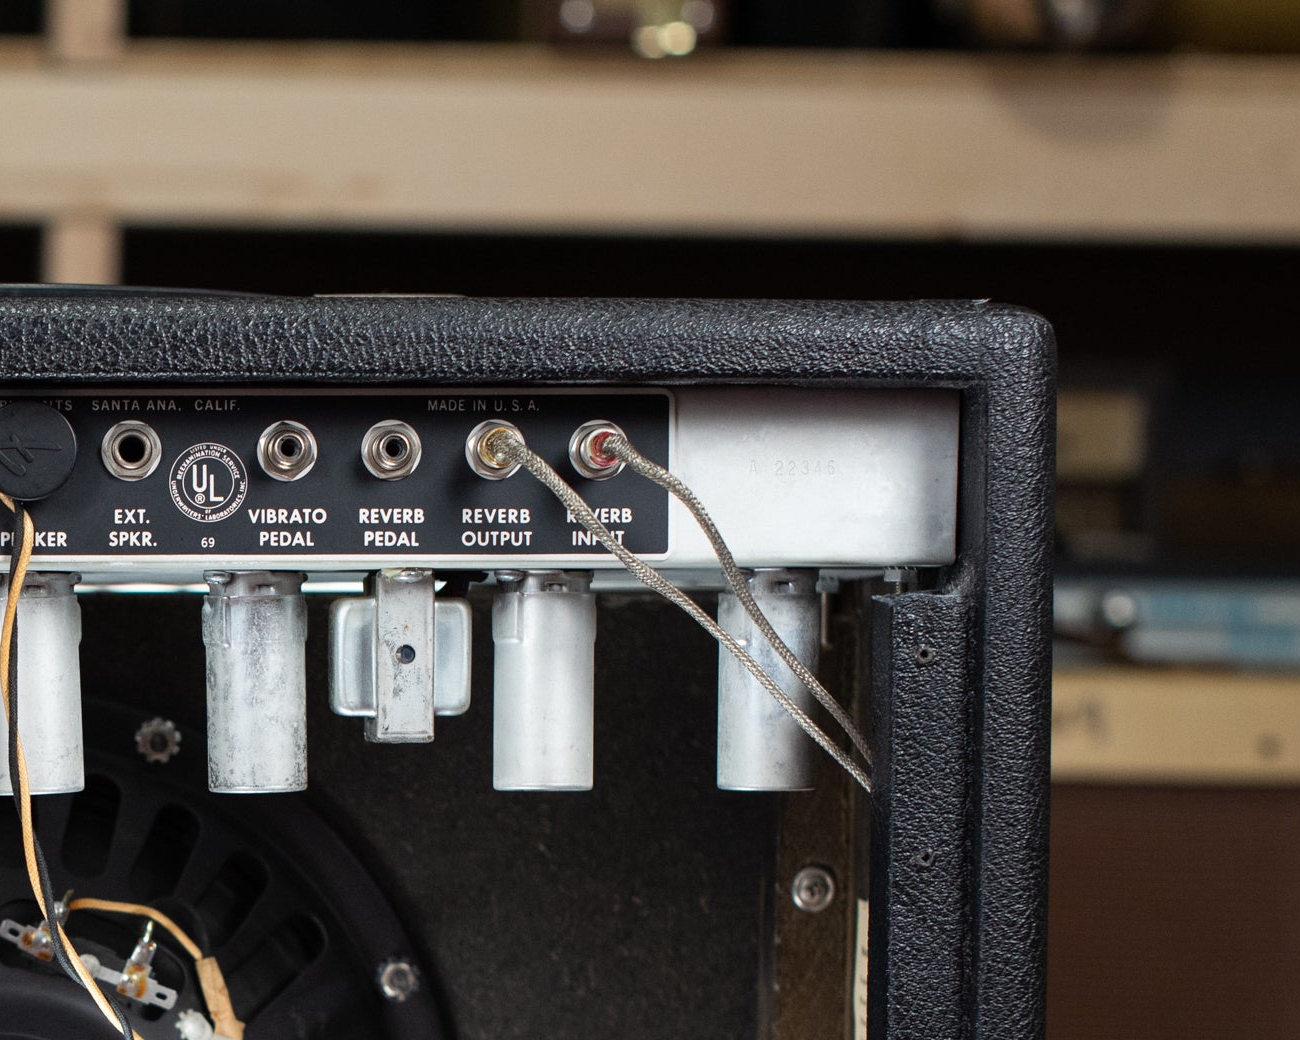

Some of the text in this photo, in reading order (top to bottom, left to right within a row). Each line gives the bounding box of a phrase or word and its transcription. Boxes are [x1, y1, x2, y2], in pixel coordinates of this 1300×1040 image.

[91, 400, 140, 411] SANTA
[194, 400, 241, 411] CALIF.
[427, 400, 466, 411] MADE
[473, 400, 486, 411] IN
[176, 449, 241, 480] REEXAMINATION SERVICE
[114, 508, 150, 524] EXT.
[248, 508, 327, 524] VIBRATO
[359, 508, 425, 524] REVERB
[462, 508, 531, 524] REVERB
[566, 508, 633, 524] RERB
[108, 531, 158, 547] SPKR.
[200, 537, 215, 549] 69
[259, 531, 315, 547] PEDAL
[364, 531, 420, 547] PEDAL
[461, 531, 533, 547] OUTPUT
